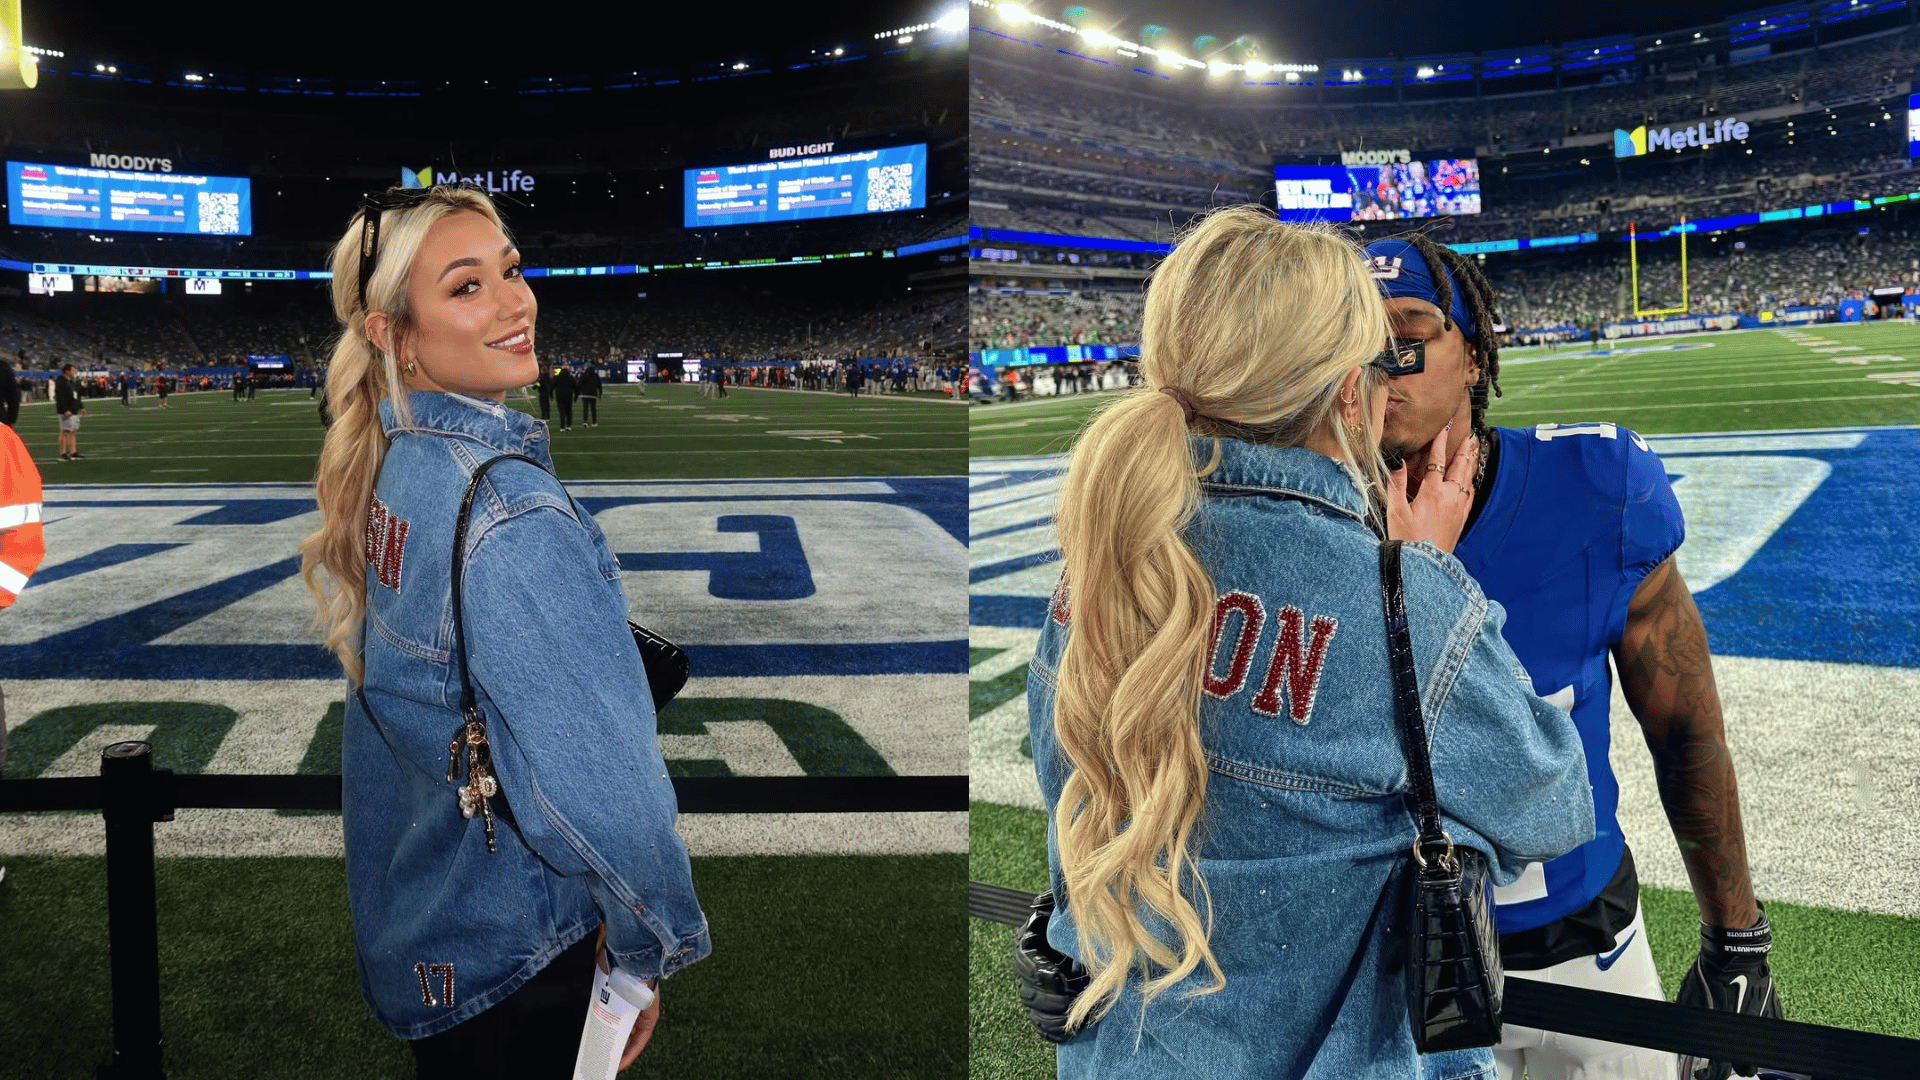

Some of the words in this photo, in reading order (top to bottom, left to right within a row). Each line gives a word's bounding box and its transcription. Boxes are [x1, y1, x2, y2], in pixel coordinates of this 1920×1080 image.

[1649, 118, 1750, 152] MetLife
[769, 147, 795, 159] BUD
[796, 142, 835, 156] LIGHT
[1341, 149, 1411, 165] MOODY'S
[90, 153, 173, 172] MOODY'S
[414, 961, 455, 1008] 17
